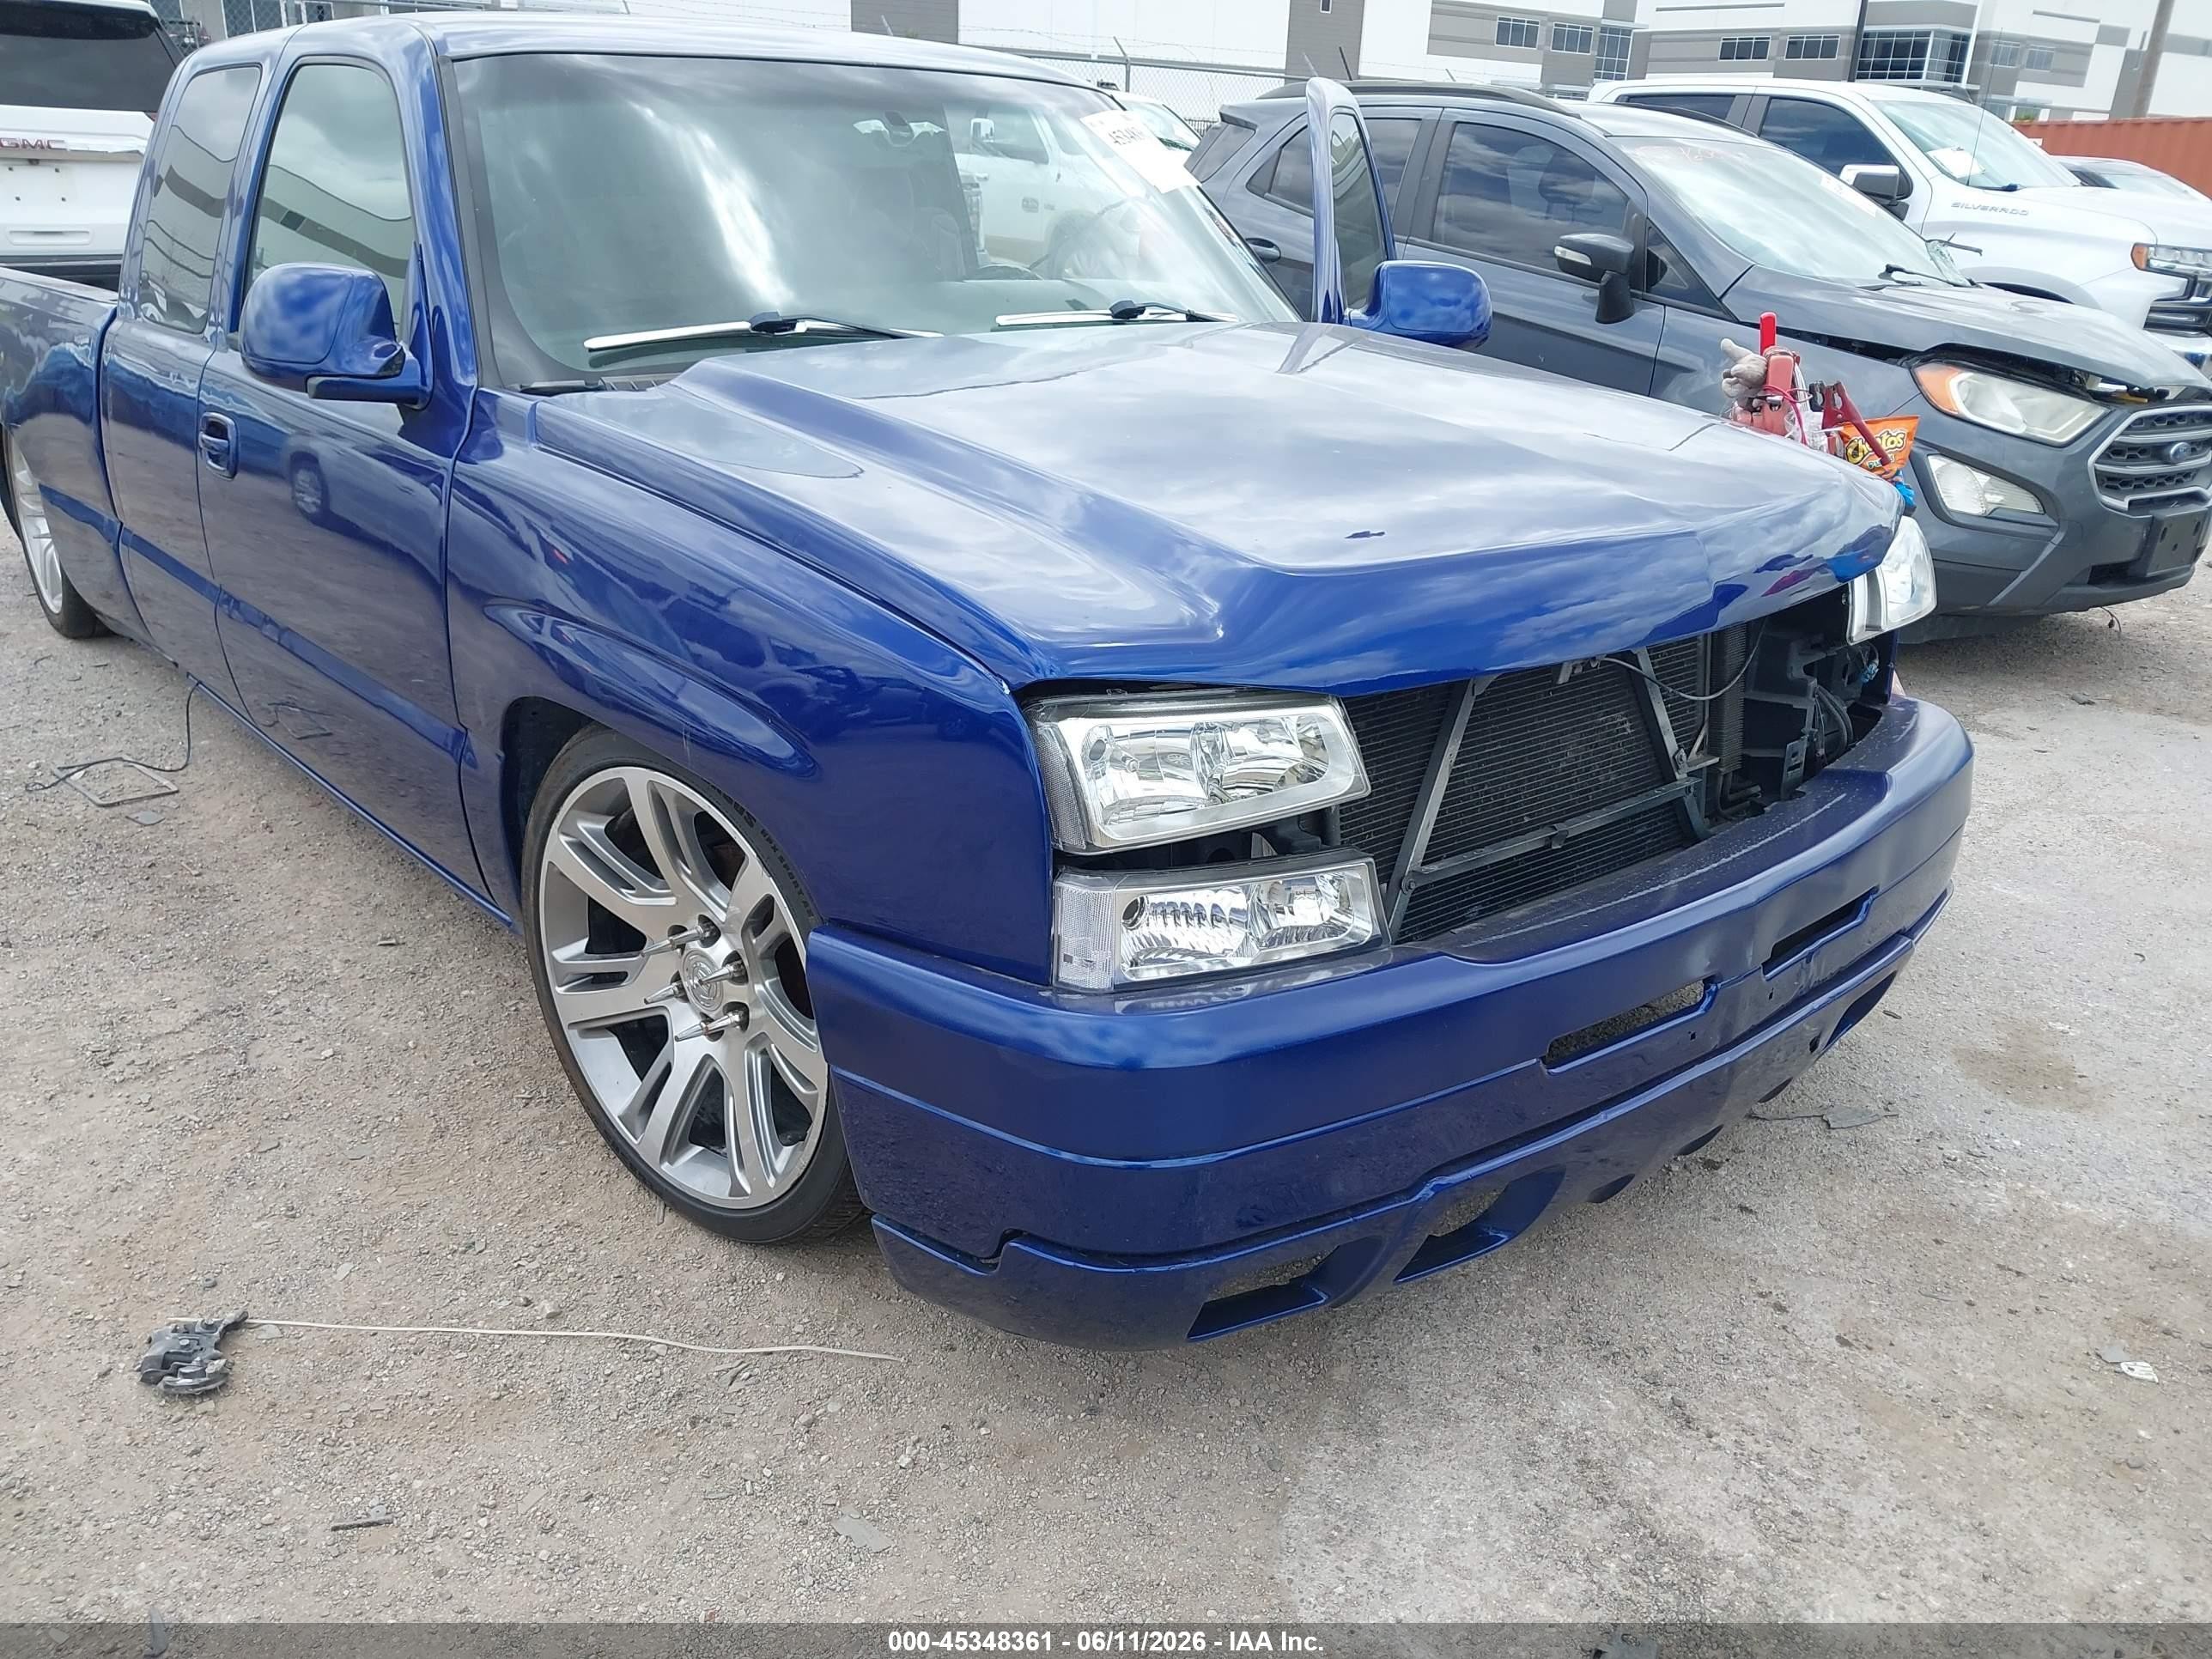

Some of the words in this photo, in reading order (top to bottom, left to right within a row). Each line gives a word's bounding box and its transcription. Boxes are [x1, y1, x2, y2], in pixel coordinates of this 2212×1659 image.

[0, 137, 67, 150] GMC
[1950, 202, 2029, 216] SILVERADO
[1845, 428, 1905, 465] Chtos
